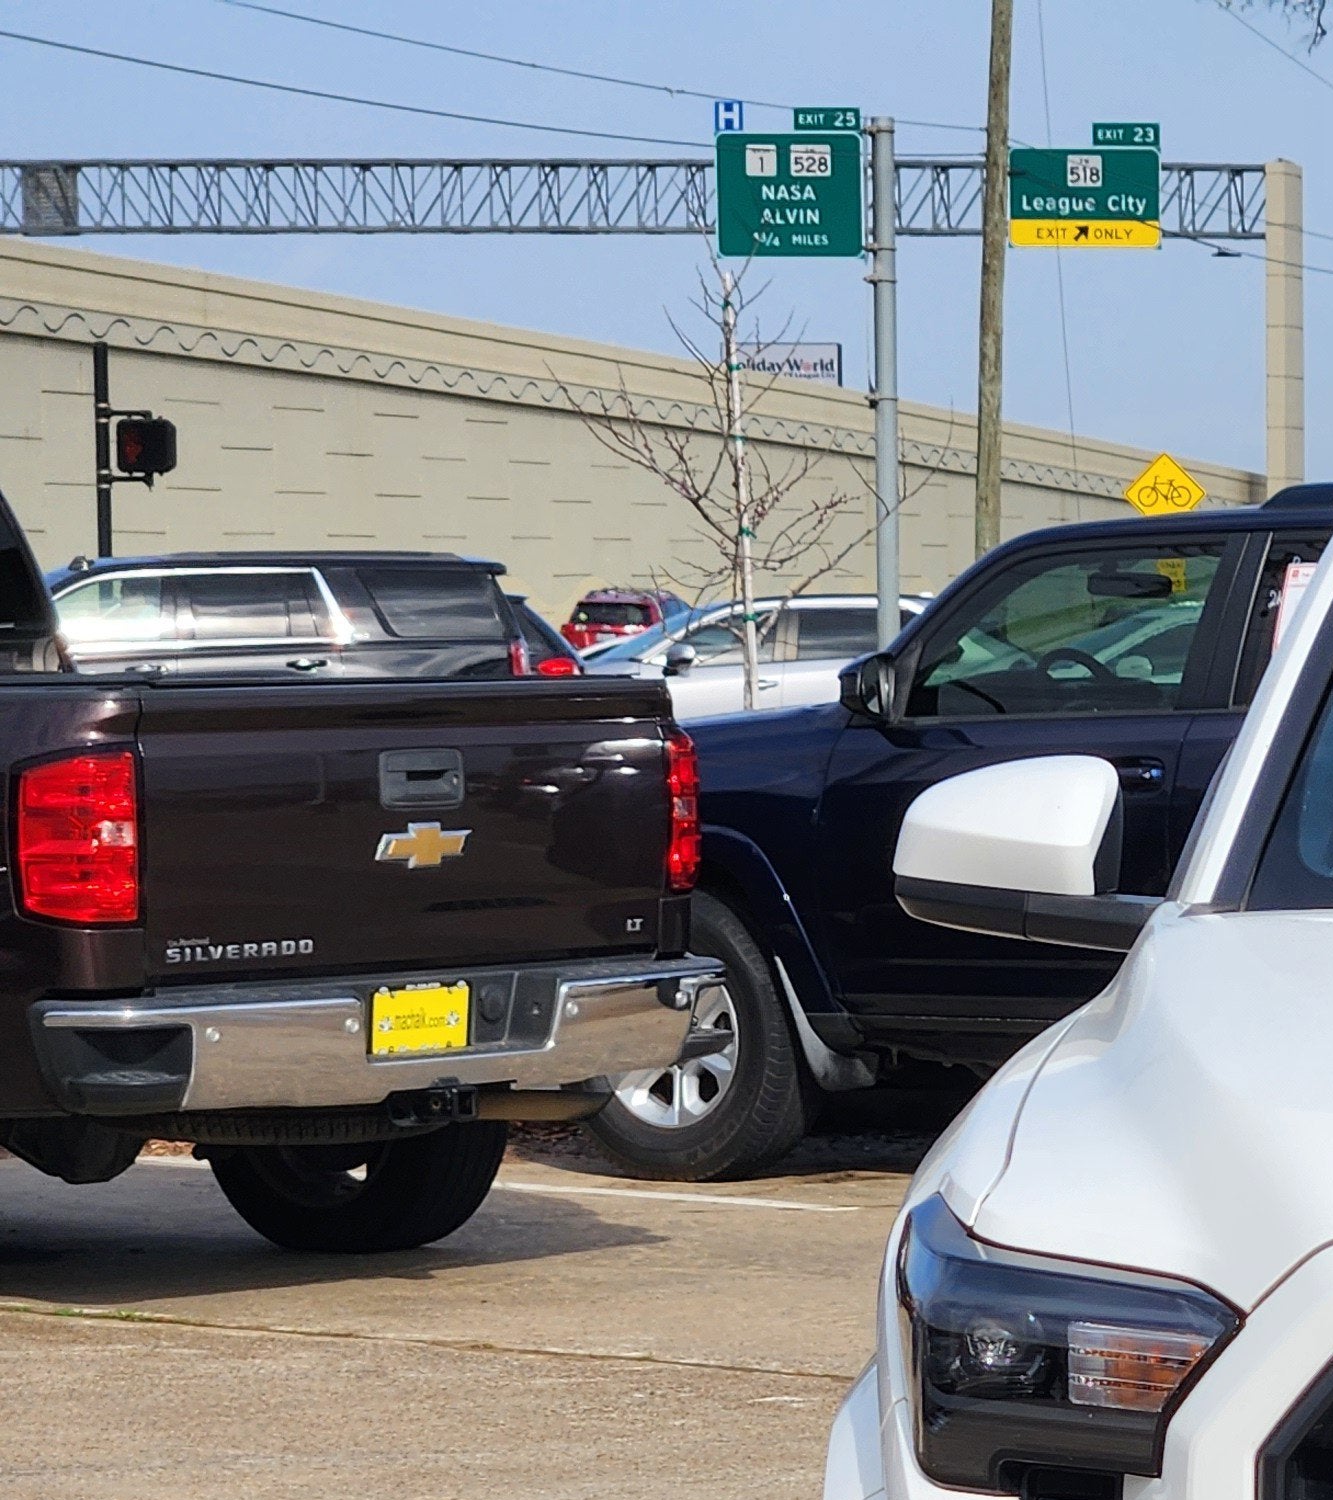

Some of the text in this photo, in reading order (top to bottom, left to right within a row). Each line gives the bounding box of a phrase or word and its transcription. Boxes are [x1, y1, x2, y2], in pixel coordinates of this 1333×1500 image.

[798, 111, 856, 127] EXIT 25
[1097, 127, 1155, 142] EXIT 23
[759, 157, 764, 173] 1
[794, 156, 829, 173] 528
[1069, 166, 1101, 183] 518
[761, 184, 817, 201] NASA
[1021, 193, 1147, 216] League City
[760, 208, 820, 225] ALVIN
[791, 234, 829, 246] MILES
[1036, 228, 1134, 240] EXIT ONLY
[626, 918, 644, 932] LT
[165, 939, 314, 964] SILVERADO
